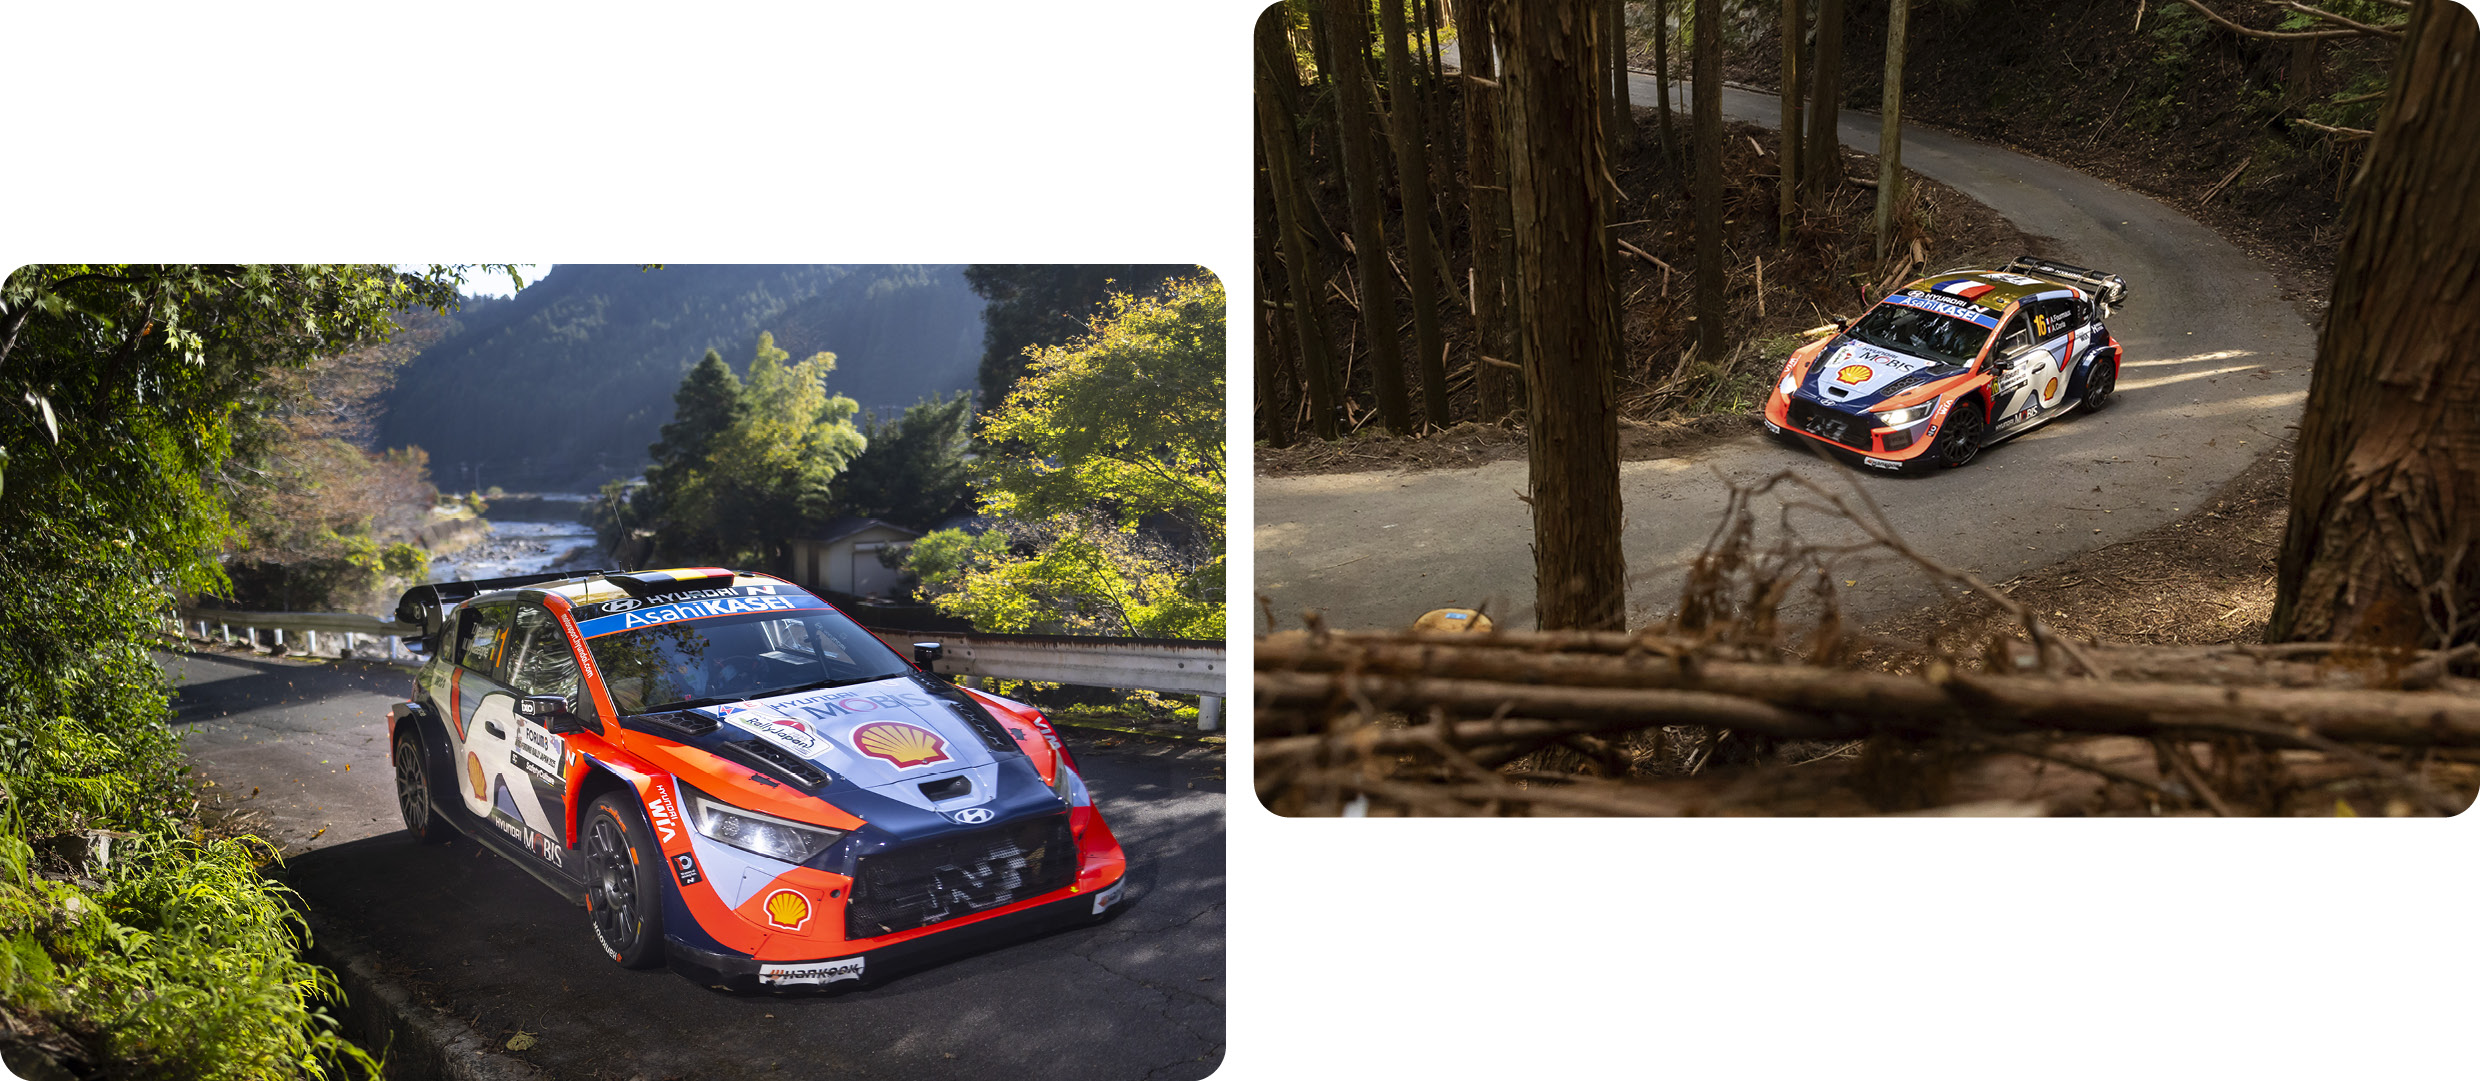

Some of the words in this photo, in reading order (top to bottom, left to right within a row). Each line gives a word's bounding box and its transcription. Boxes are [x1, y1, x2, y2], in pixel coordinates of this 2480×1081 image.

[1899, 297, 1980, 322] AsahiKASEI
[1925, 293, 1967, 307] HYUNDAI
[2033, 314, 2047, 337] 16
[1860, 352, 1915, 373] MOBIS
[1862, 347, 1899, 359] HYUNDAI
[2014, 406, 2038, 423] MOBIS
[646, 588, 739, 604] HYUNDAI
[747, 585, 777, 596] N
[626, 596, 797, 629] AsahiKASEI
[496, 626, 510, 668] 1
[561, 613, 594, 679] motorsport.hyundai.com
[770, 691, 859, 710] HYUNDAI
[801, 693, 932, 720] MOBIS
[566, 749, 577, 767] N
[656, 784, 678, 820] HYUNDAI
[495, 816, 522, 842] HYUNDAI
[523, 826, 562, 868] MOBIS
